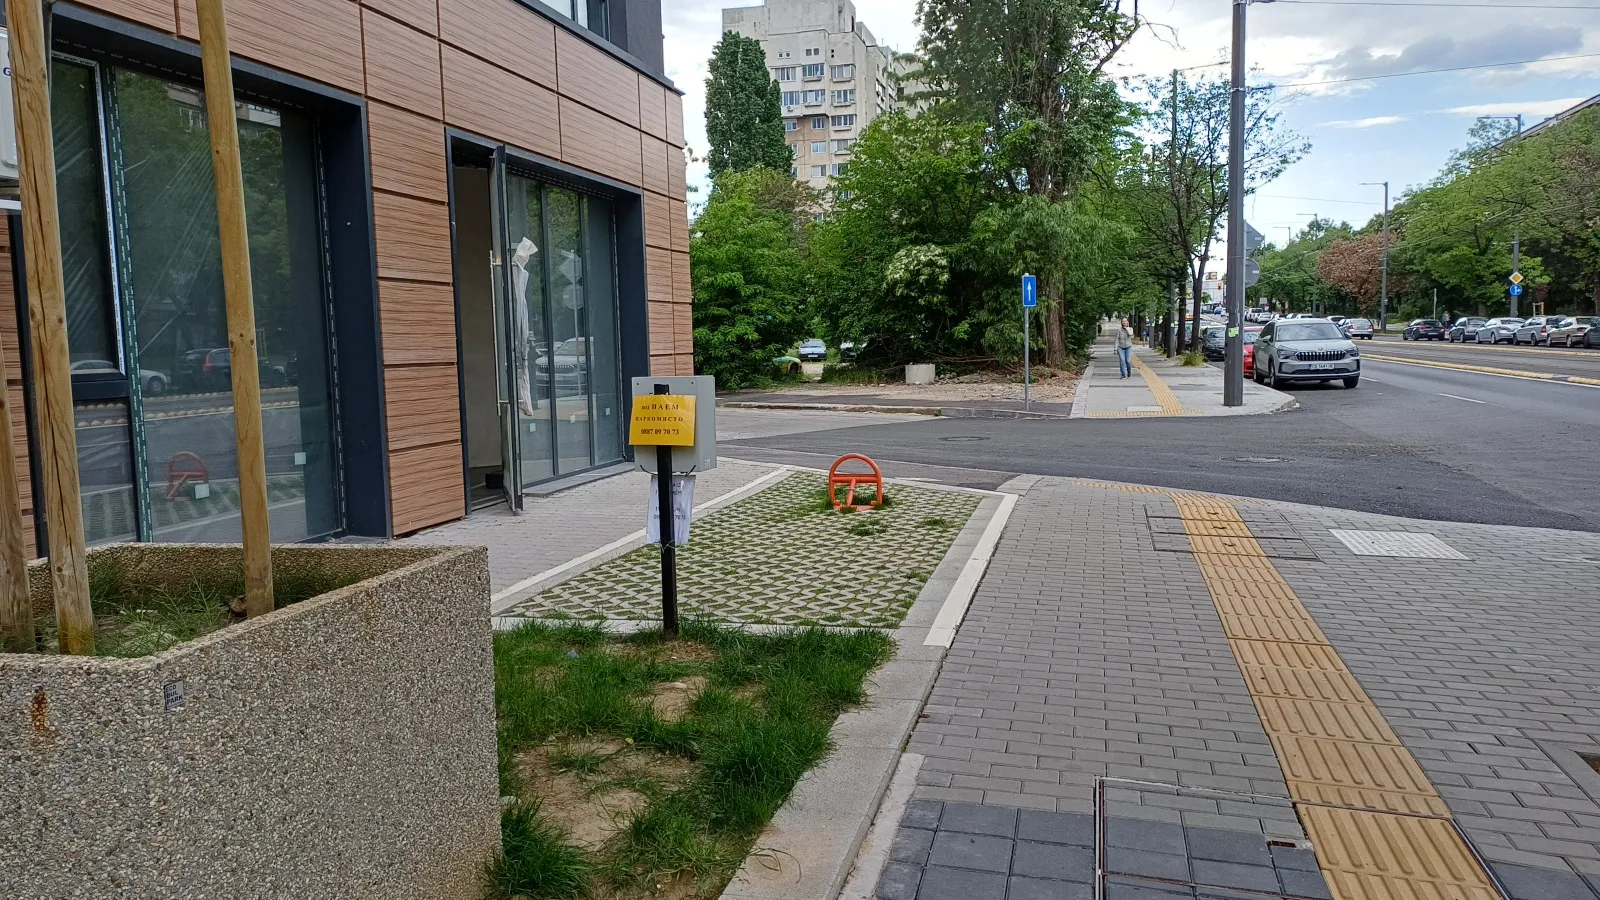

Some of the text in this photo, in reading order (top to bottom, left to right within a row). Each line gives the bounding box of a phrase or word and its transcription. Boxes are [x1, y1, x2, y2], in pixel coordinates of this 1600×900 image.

[166, 684, 176, 692] ECO
[166, 690, 178, 698] BUL
[166, 694, 183, 705] PARK
